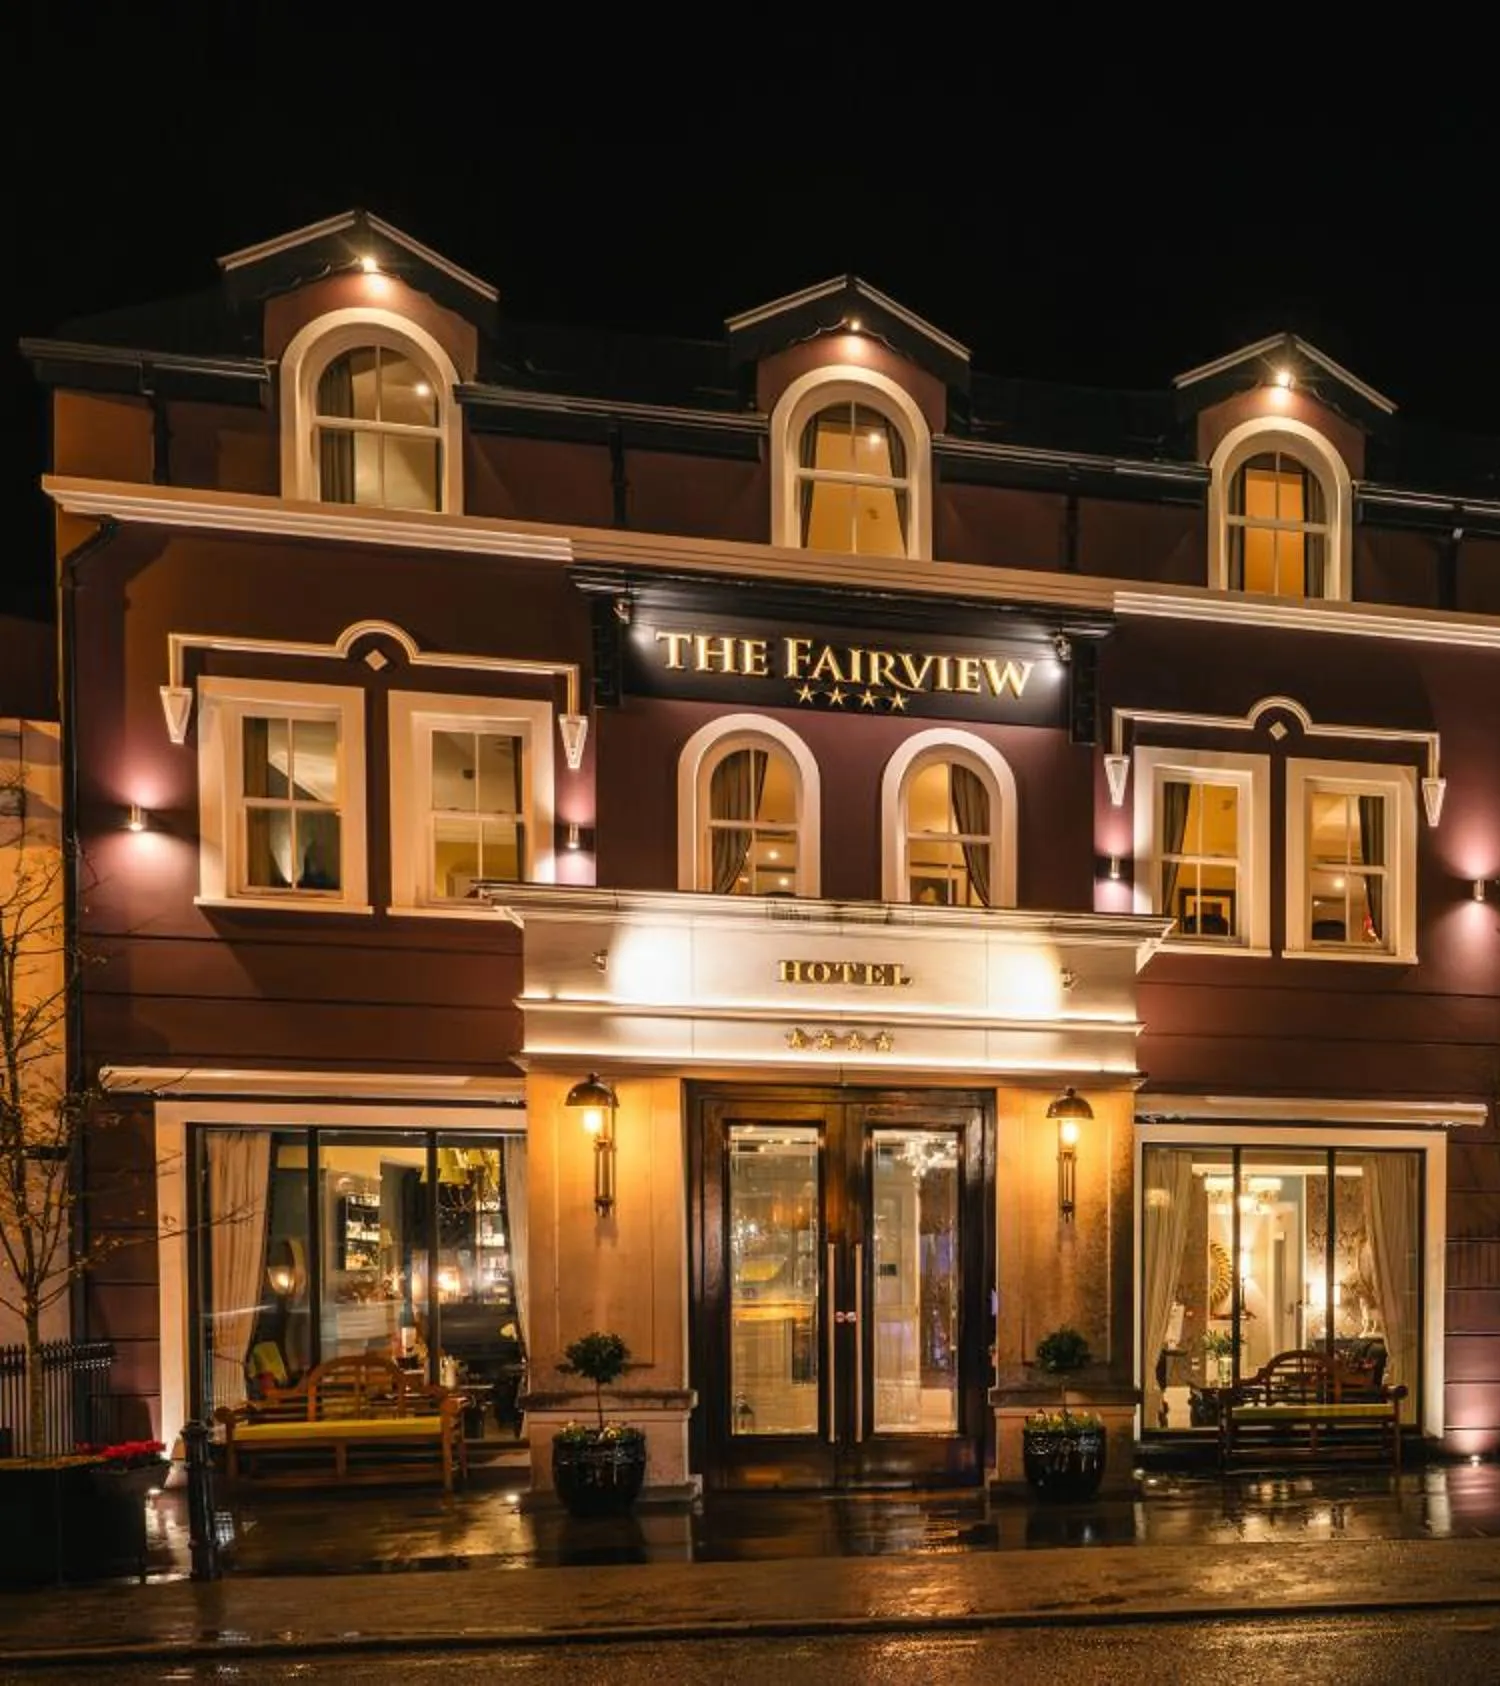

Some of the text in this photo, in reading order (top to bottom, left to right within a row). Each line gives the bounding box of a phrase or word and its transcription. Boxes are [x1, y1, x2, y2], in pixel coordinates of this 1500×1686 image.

[656, 630, 1035, 698] THE FAIRVIEW
[777, 959, 914, 986] HOTEL
